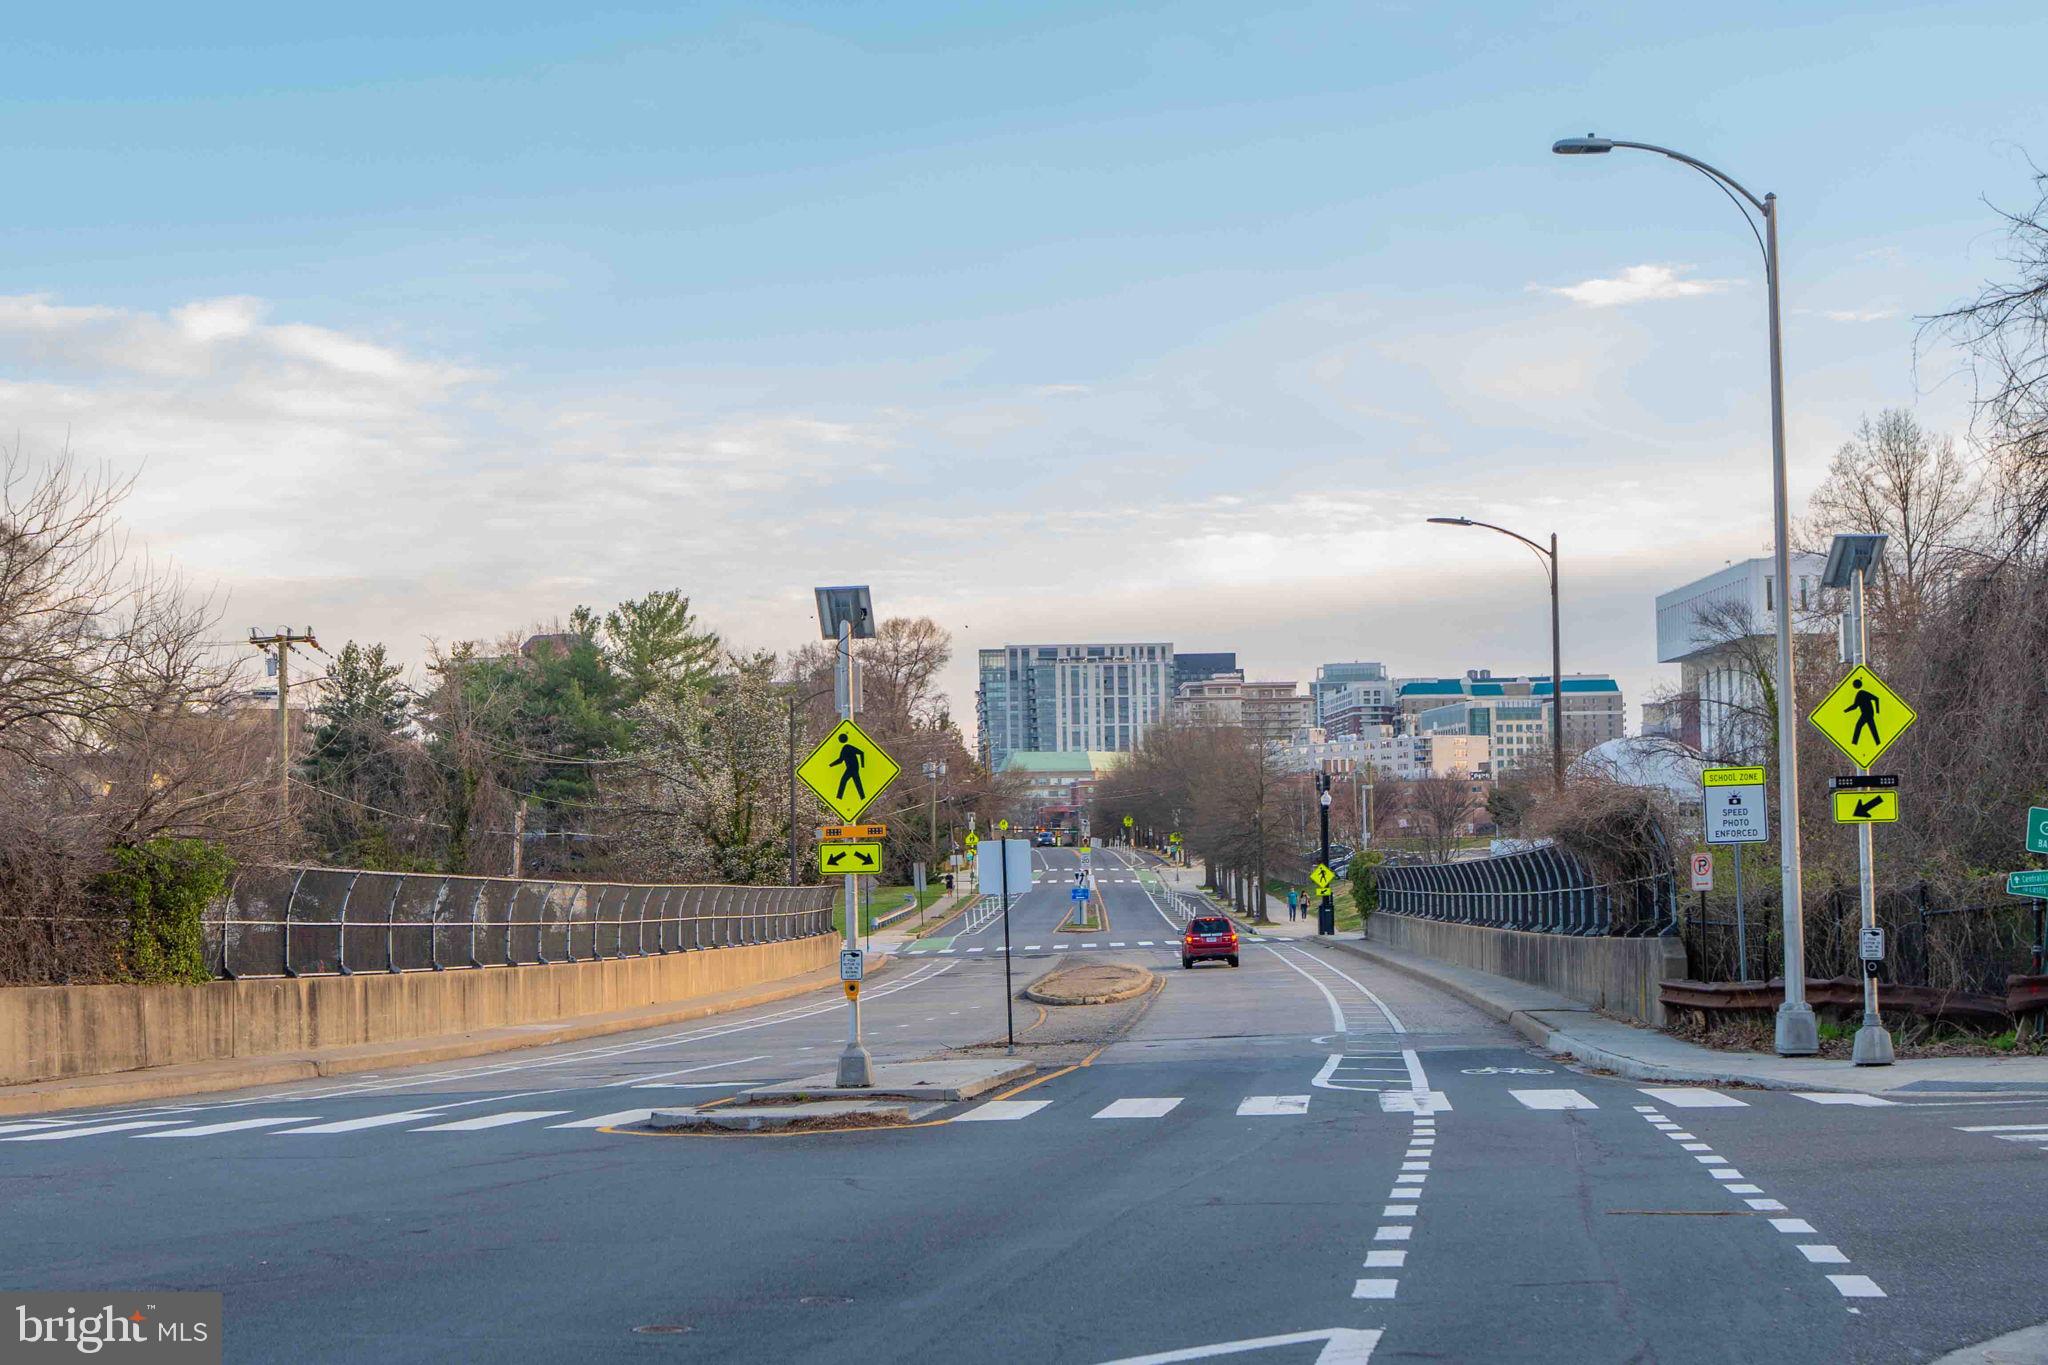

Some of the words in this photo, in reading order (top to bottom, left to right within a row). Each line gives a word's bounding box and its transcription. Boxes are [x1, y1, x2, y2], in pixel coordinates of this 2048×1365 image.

[1709, 773, 1738, 782] SCHOOL
[1739, 772, 1758, 781] ZONE
[1722, 808, 1749, 817] SPEED
[1723, 818, 1750, 827] PHOTO
[1715, 829, 1758, 838] ENFORCED
